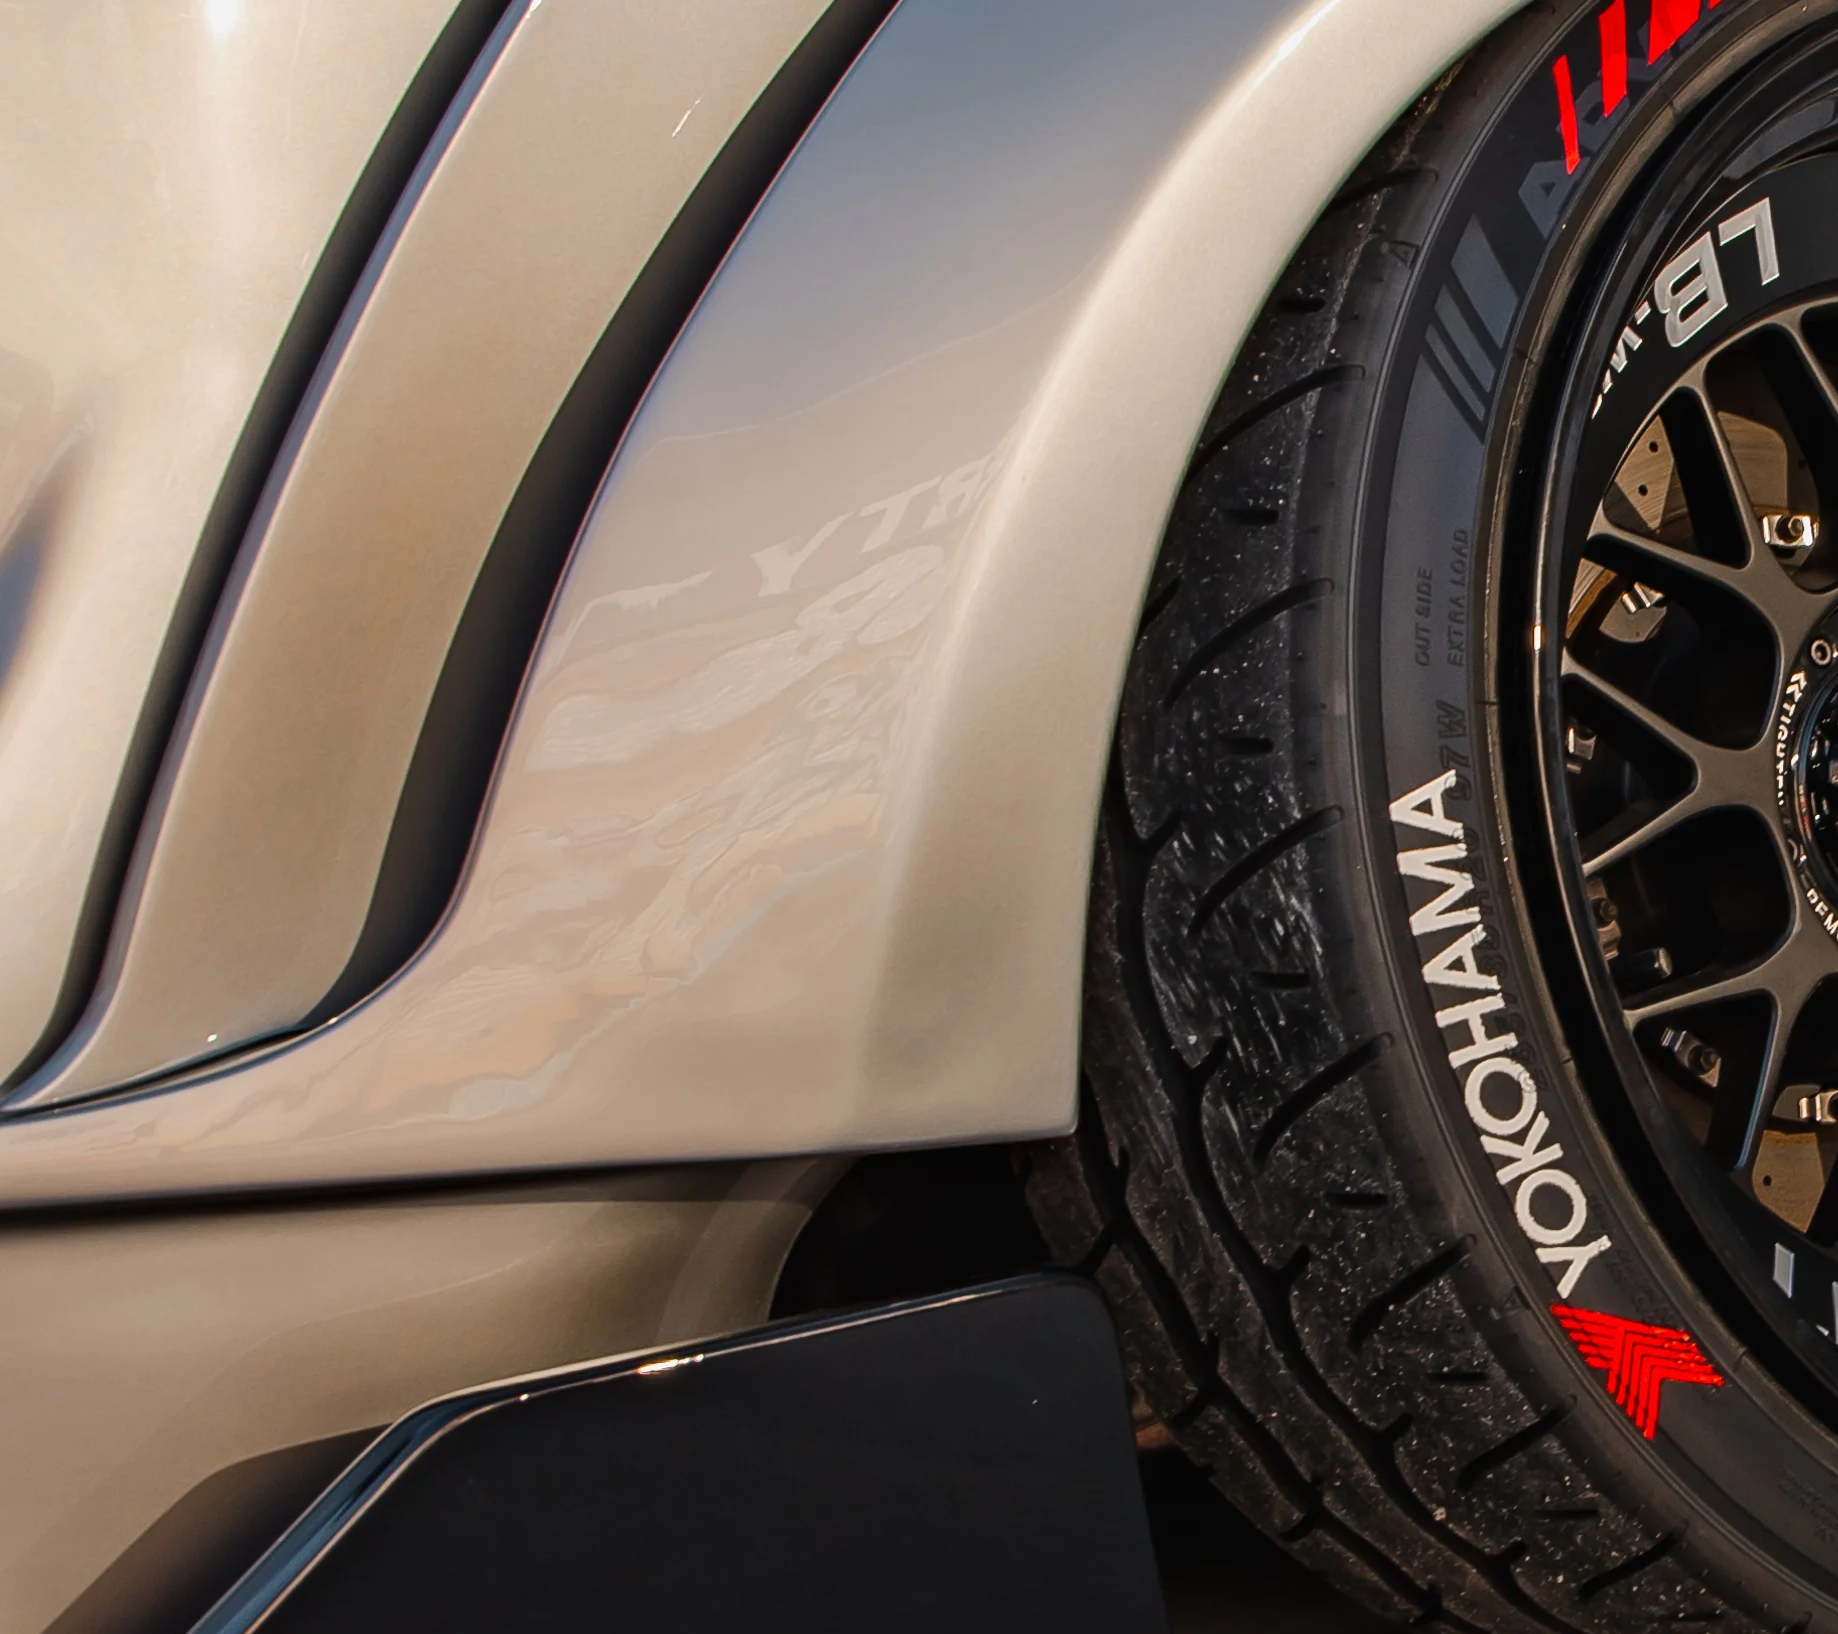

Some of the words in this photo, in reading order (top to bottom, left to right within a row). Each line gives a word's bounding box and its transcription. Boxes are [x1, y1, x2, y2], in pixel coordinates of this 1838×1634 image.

[1449, 528, 1471, 584] LOAD
[1415, 567, 1434, 617] SIDE
[1414, 624, 1432, 667] OUT
[1446, 593, 1466, 667] EXTRA
[1389, 769, 1612, 1299] YOKOHAMA
